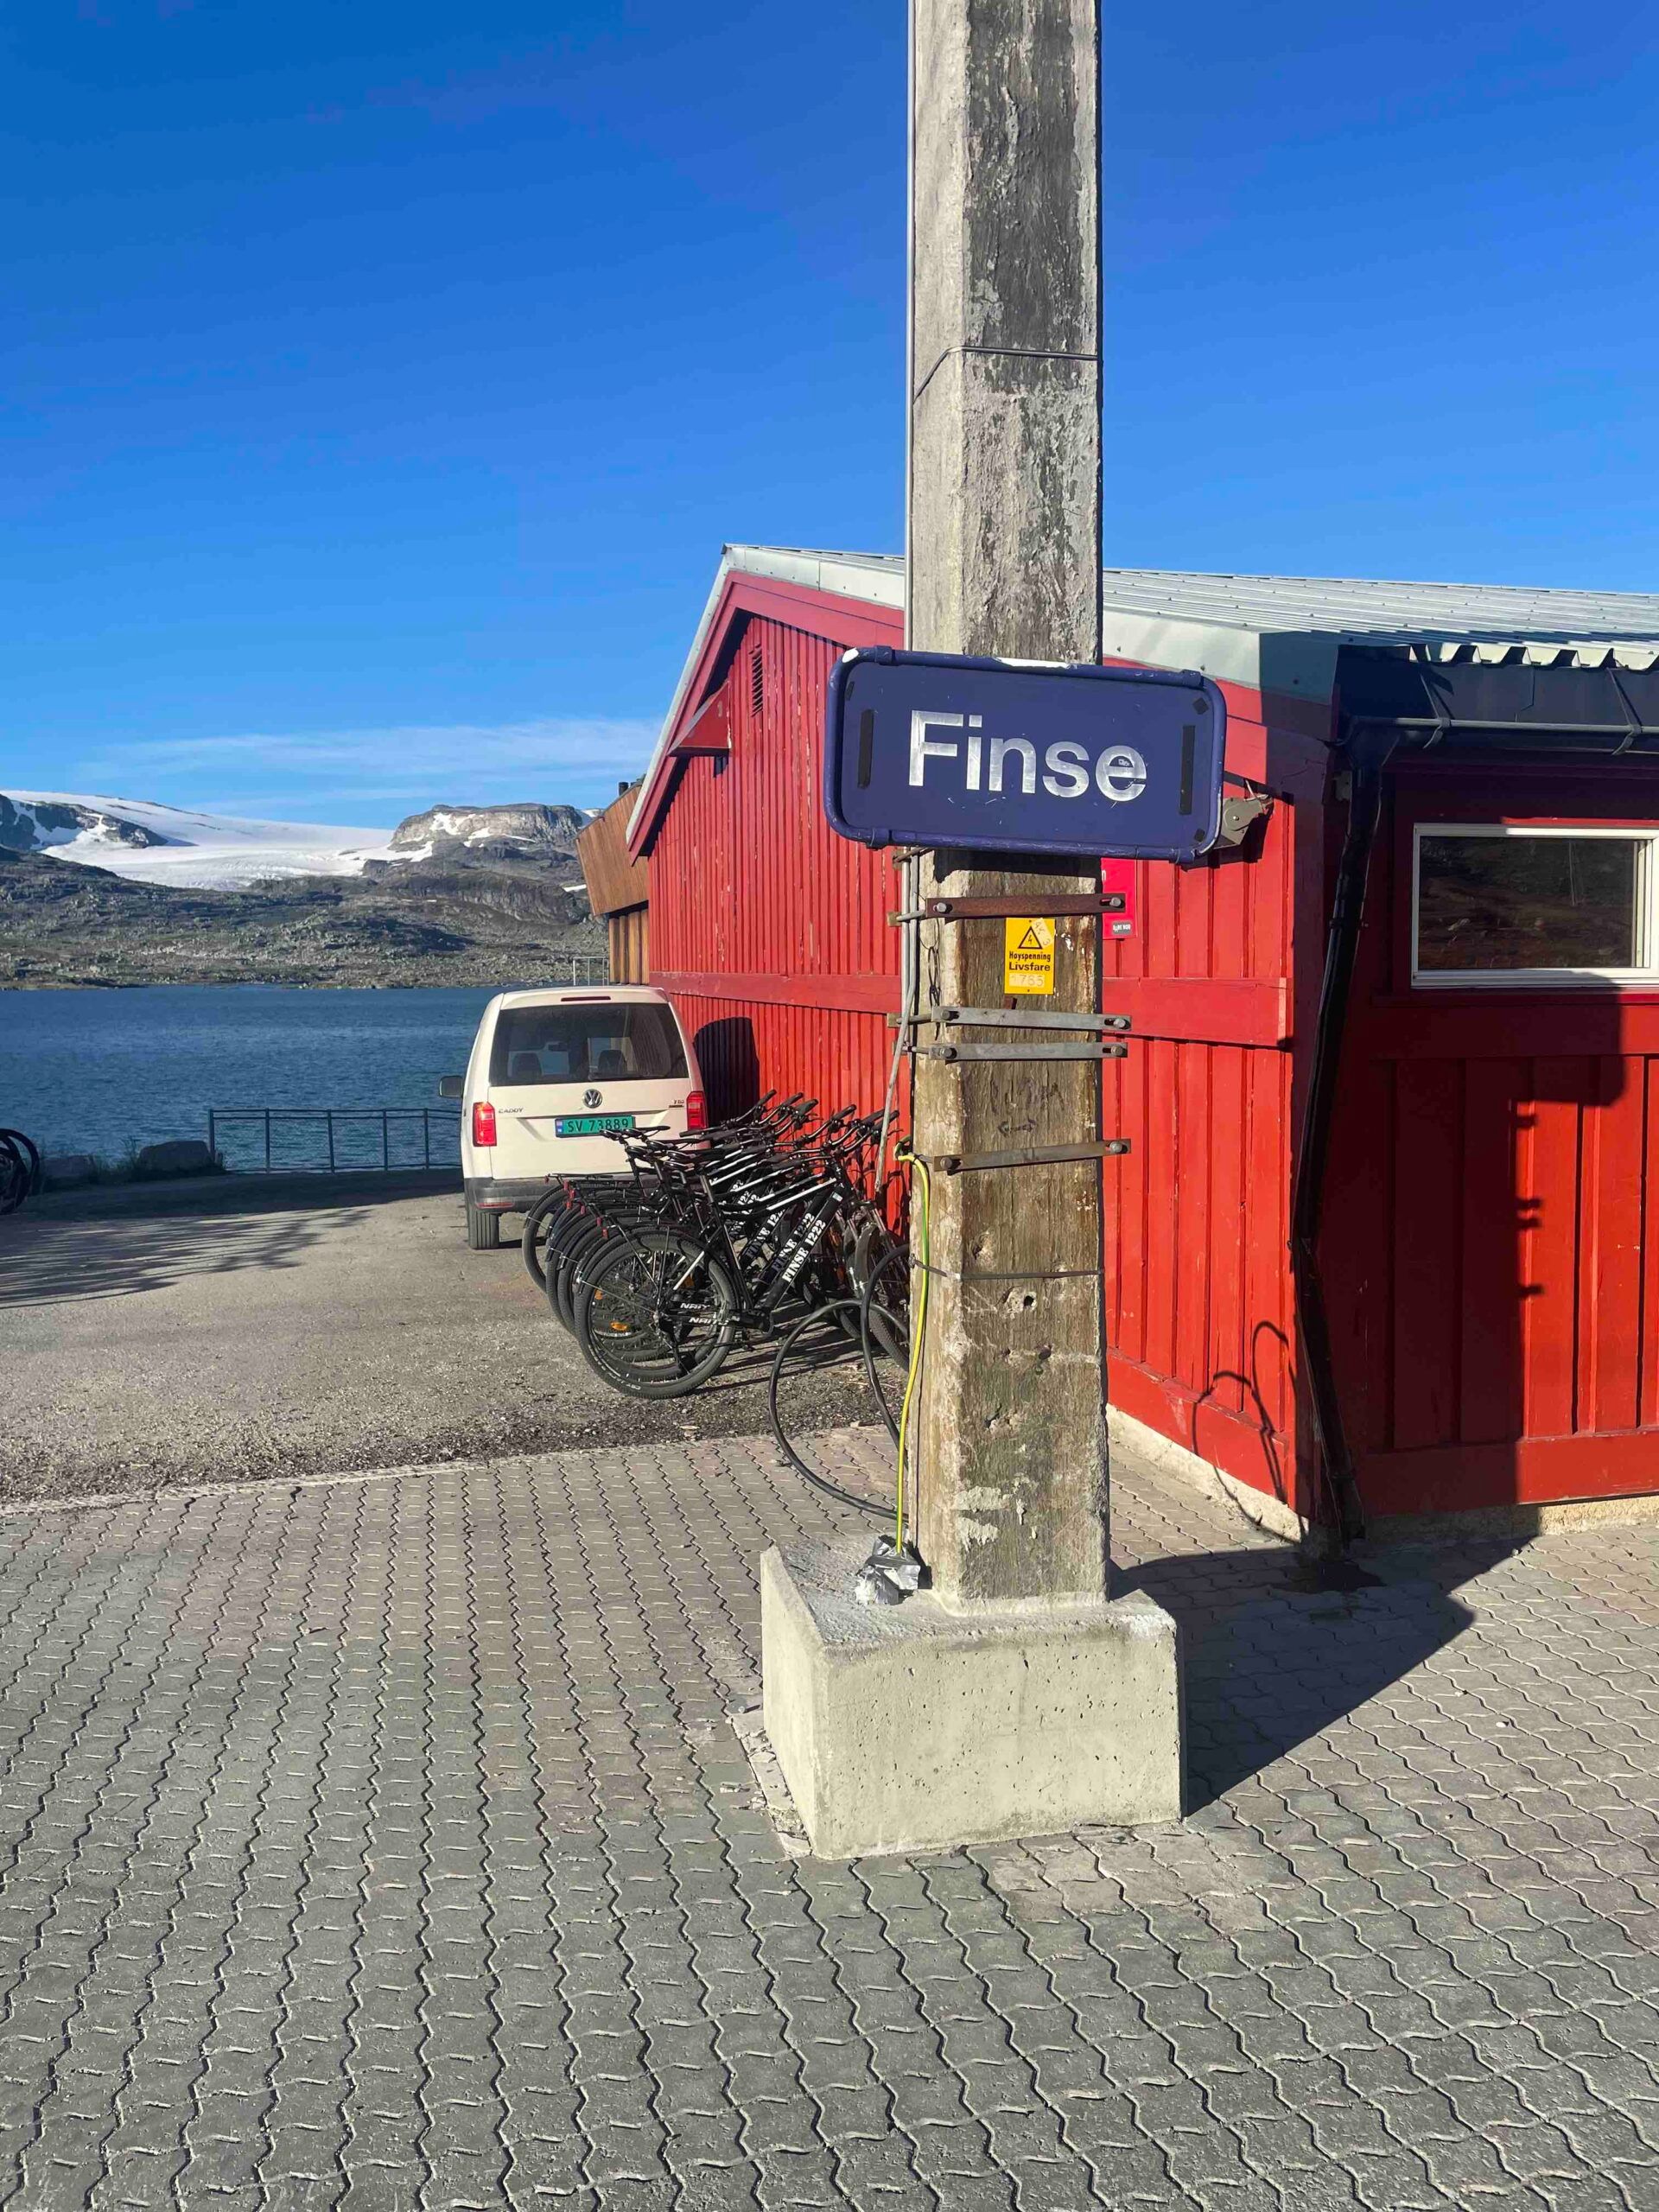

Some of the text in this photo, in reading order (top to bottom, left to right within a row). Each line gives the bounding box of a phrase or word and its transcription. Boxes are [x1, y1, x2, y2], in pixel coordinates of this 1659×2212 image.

[908, 709, 1147, 802] Finse
[1008, 961, 1051, 971] Livsfare
[567, 1118, 629, 1134] SV 73889
[771, 1238, 798, 1272] FINSE
[781, 1219, 827, 1283] FINSE 1222
